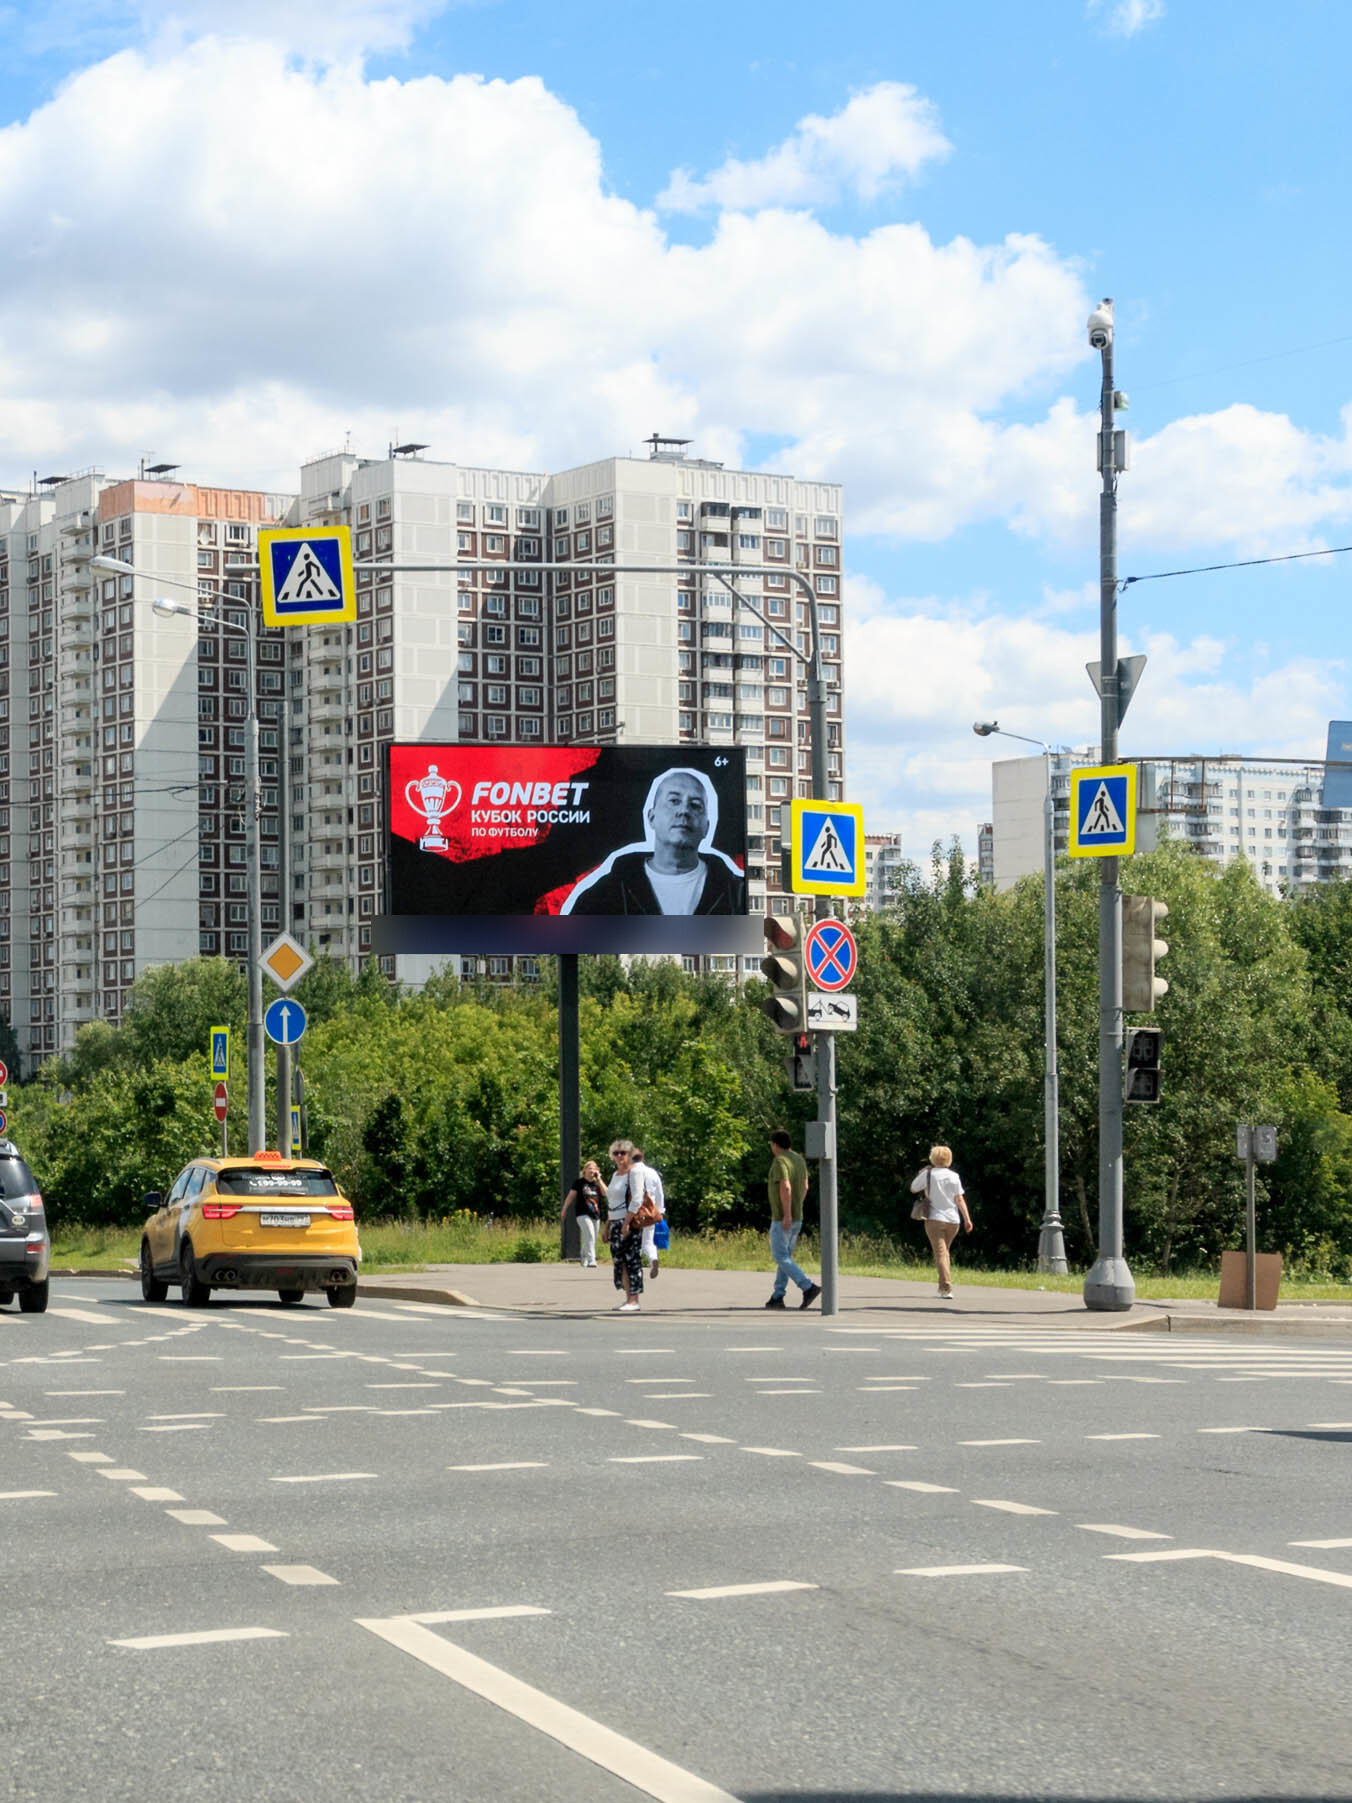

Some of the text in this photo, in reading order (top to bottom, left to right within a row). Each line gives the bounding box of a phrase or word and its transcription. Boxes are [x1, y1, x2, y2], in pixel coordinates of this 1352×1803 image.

[714, 756, 729, 767] 6+
[471, 782, 590, 806] FONBET
[471, 810, 590, 823] КУБОК РОССИИ
[471, 827, 539, 837] ПО ФУТБОЛУ
